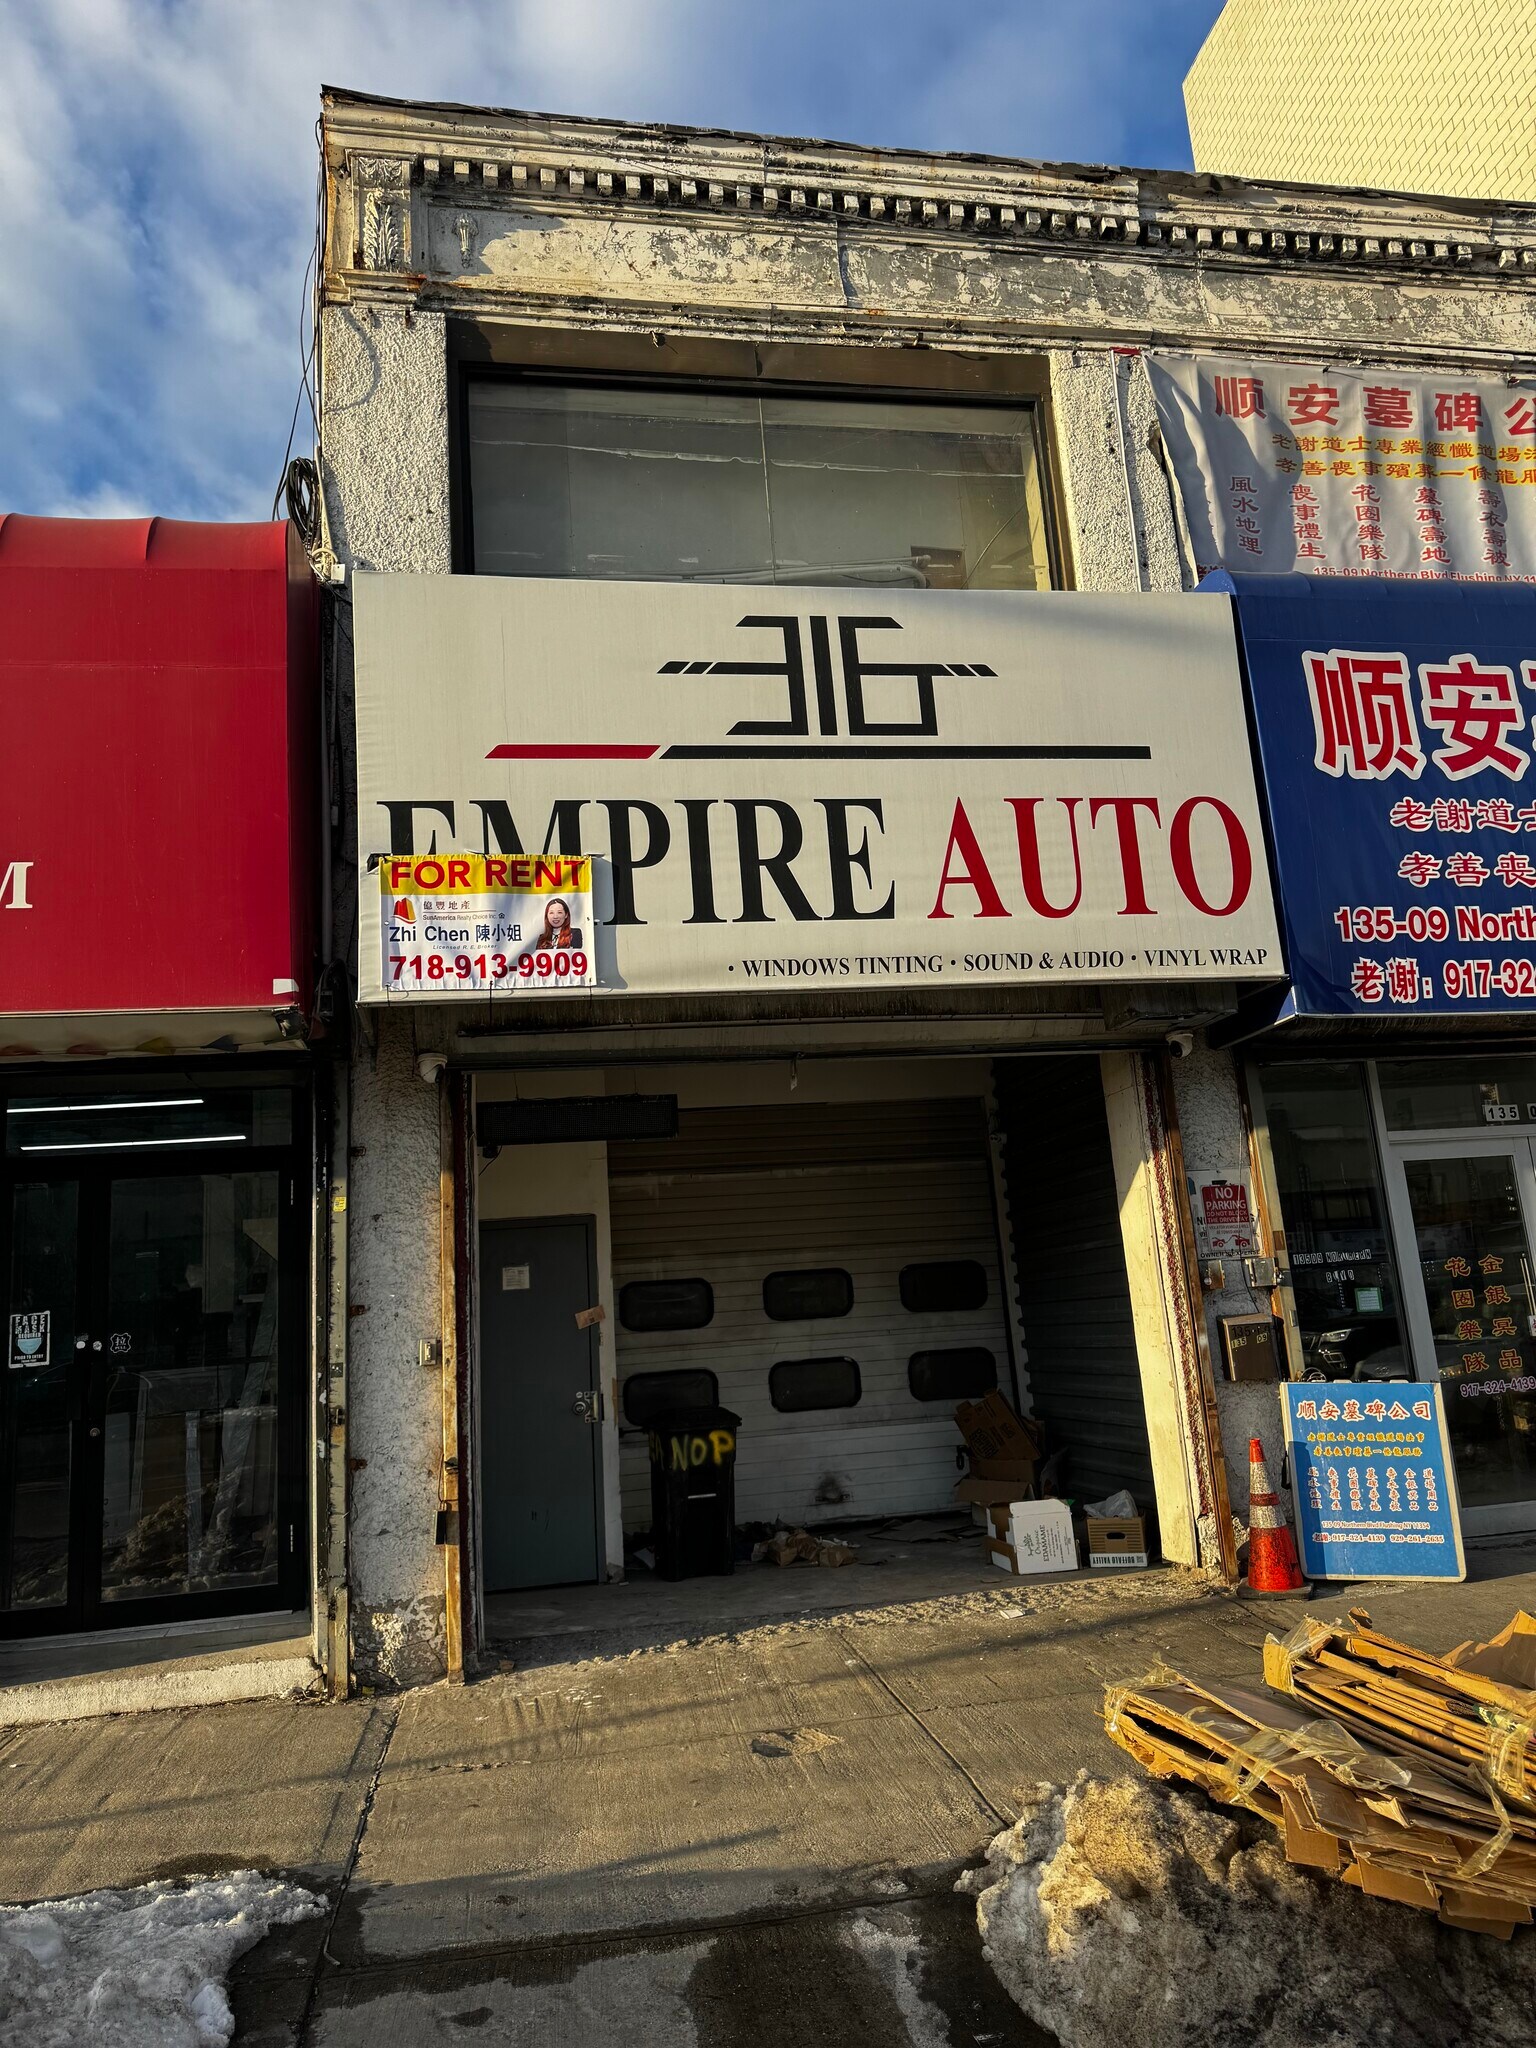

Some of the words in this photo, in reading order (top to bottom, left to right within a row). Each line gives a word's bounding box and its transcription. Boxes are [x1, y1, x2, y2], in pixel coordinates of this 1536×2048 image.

[1229, 476, 1263, 556] 風水地理
[1288, 483, 1327, 561] 喪事禮生
[1351, 483, 1388, 561] 花圈樂隊
[1414, 486, 1451, 563] 墓碑壽地
[1477, 488, 1511, 567] 壽衣壽被
[1313, 566, 1358, 576] 135-09
[1360, 568, 1419, 579] Northern
[1420, 570, 1448, 579] Blvd
[1303, 650, 1536, 780] 顺安
[926, 795, 1253, 919] AUTO
[1398, 851, 1536, 888] 孝善喪
[391, 859, 471, 889] FOR
[485, 859, 586, 888] RENT
[389, 925, 417, 942] Zhi
[424, 925, 470, 942] Chen
[475, 924, 523, 943] 陳小姐
[1335, 906, 1449, 942] 135-09
[389, 951, 588, 981] 718-913-9909
[741, 957, 851, 978] WINDOWS
[854, 954, 944, 975] TINTING
[963, 951, 1033, 972] SOUND
[1037, 951, 1055, 970] &
[1058, 949, 1125, 970] AUDIO
[1144, 948, 1207, 968] VINYL
[1208, 948, 1268, 967] WRAP
[1443, 958, 1536, 999] 917-32
[1488, 1106, 1518, 1119] 135
[1205, 1199, 1247, 1211] PARKING
[1214, 1187, 1233, 1199] NO
[1293, 1252, 1324, 1265] 13509
[15, 1314, 45, 1326] FACE
[1445, 1256, 1489, 1373] 花圈樂隊
[1478, 1253, 1523, 1370] 金銀冥品
[15, 1324, 45, 1335] MASK
[1459, 1376, 1536, 1397] 917-324-4139
[1296, 1399, 1433, 1422] 顺安墓碑公司
[1039, 1524, 1049, 1562] EDAMAME
